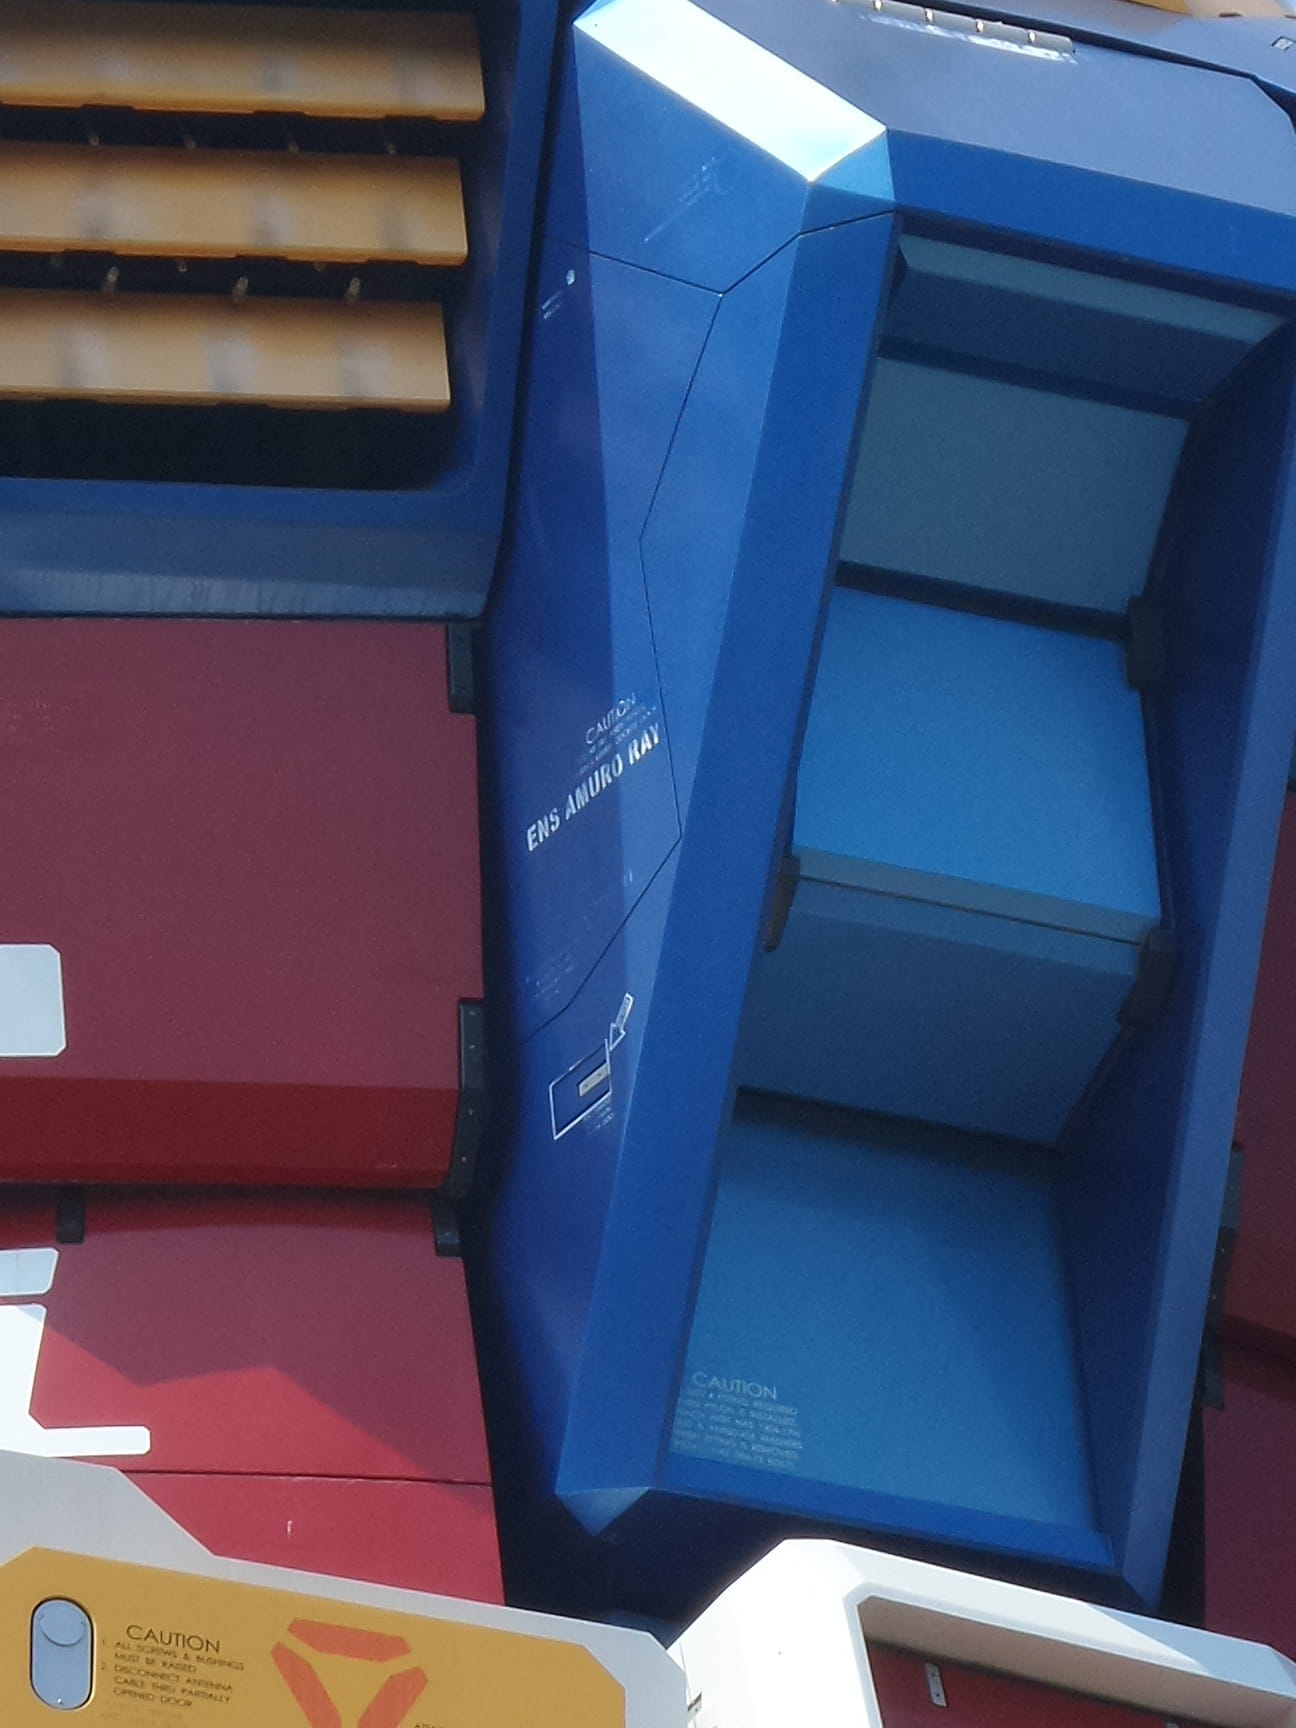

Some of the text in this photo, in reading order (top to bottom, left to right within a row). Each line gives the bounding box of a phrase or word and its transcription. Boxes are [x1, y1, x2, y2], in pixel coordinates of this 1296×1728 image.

[526, 807, 561, 852] ENS
[565, 753, 624, 821] AMURO
[628, 723, 661, 765] RAY
[691, 1370, 778, 1402] CAUTION
[125, 1624, 221, 1654] CAUTION
